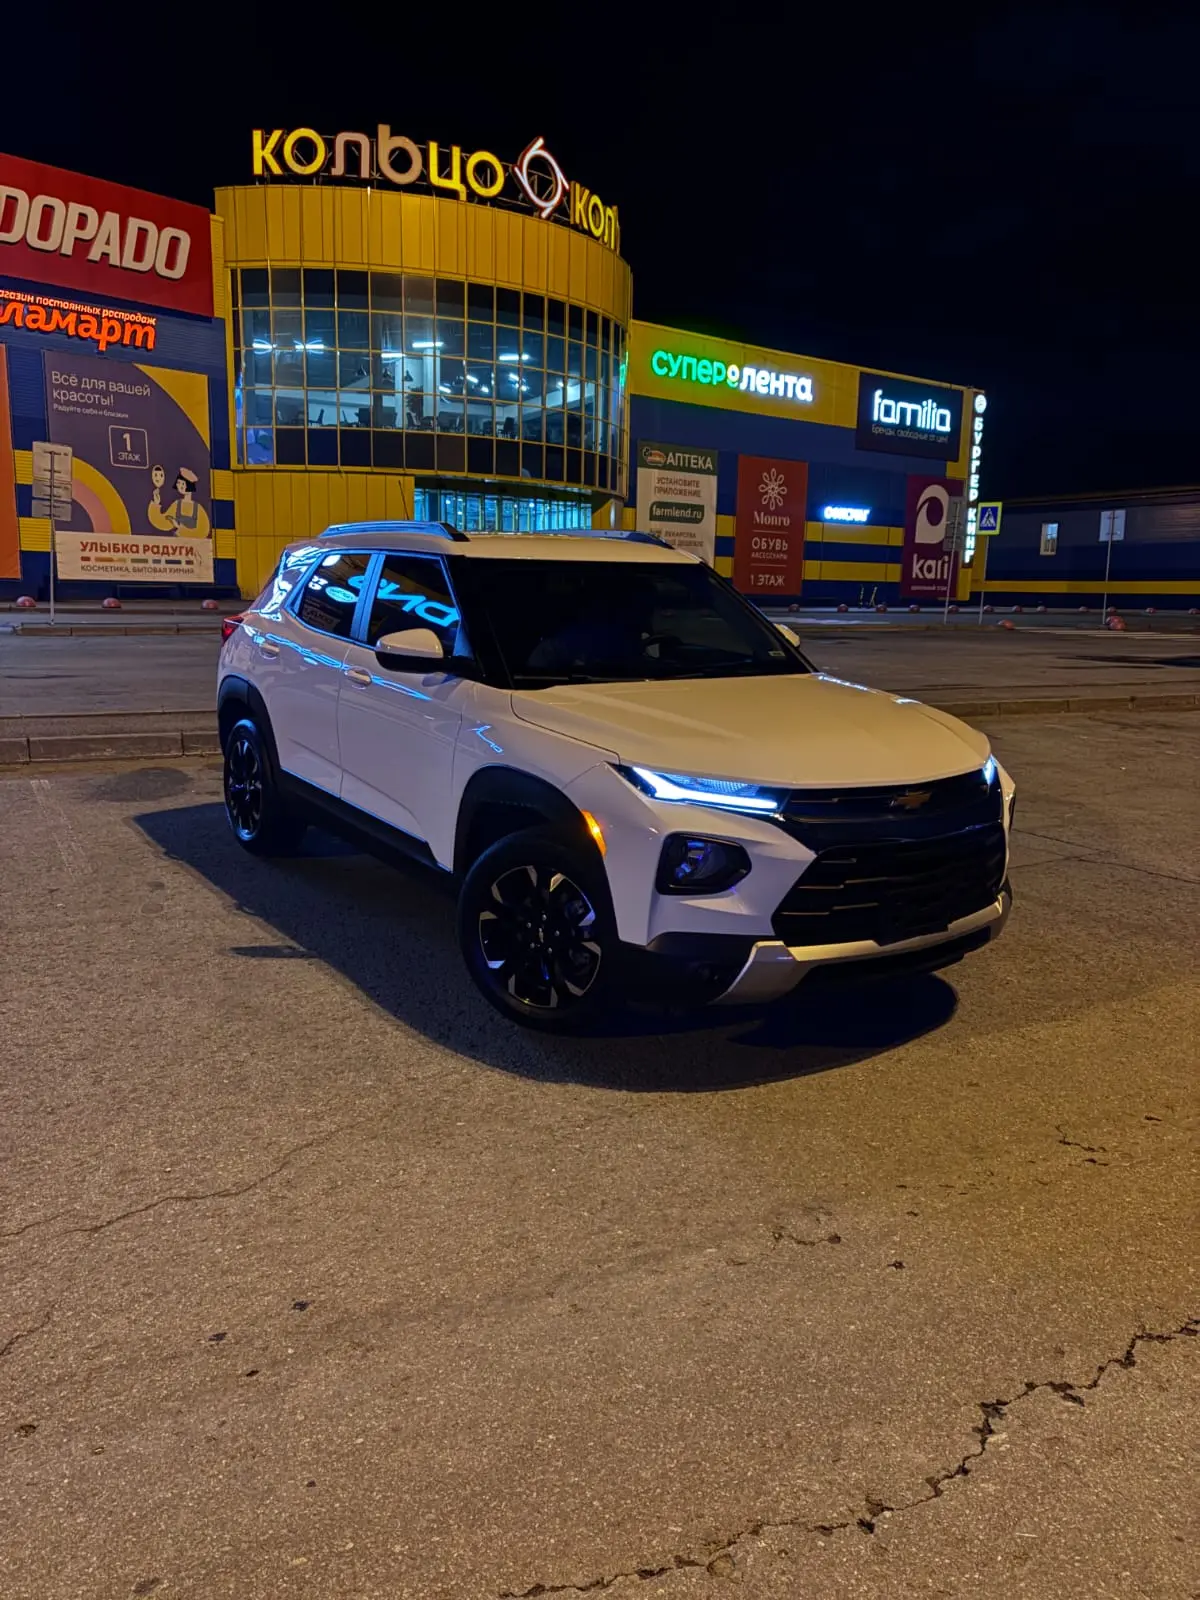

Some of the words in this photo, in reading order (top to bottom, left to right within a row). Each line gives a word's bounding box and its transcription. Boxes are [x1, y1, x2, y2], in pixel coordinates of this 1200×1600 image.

[81, 378, 106, 390] для
[109, 381, 151, 397] вашей
[53, 388, 114, 406] красоты!
[873, 389, 951, 432] familia
[123, 433, 131, 451] 1
[118, 452, 141, 462] ЭТАЖ
[666, 452, 713, 470] АПТЕКА
[969, 417, 984, 501] БУРГЕР
[656, 477, 700, 488] УСТАНОВИТЕ
[652, 505, 702, 518] farmlend.ru
[753, 511, 790, 526] Monro
[751, 537, 788, 551] ОБУВЬ
[964, 507, 977, 564] КИНГ
[80, 565, 131, 573] КОСМЕТИКА,
[132, 566, 167, 574] БЫТОВАЯ
[912, 553, 949, 579] kari
[757, 575, 785, 586] ЭТАЖ
